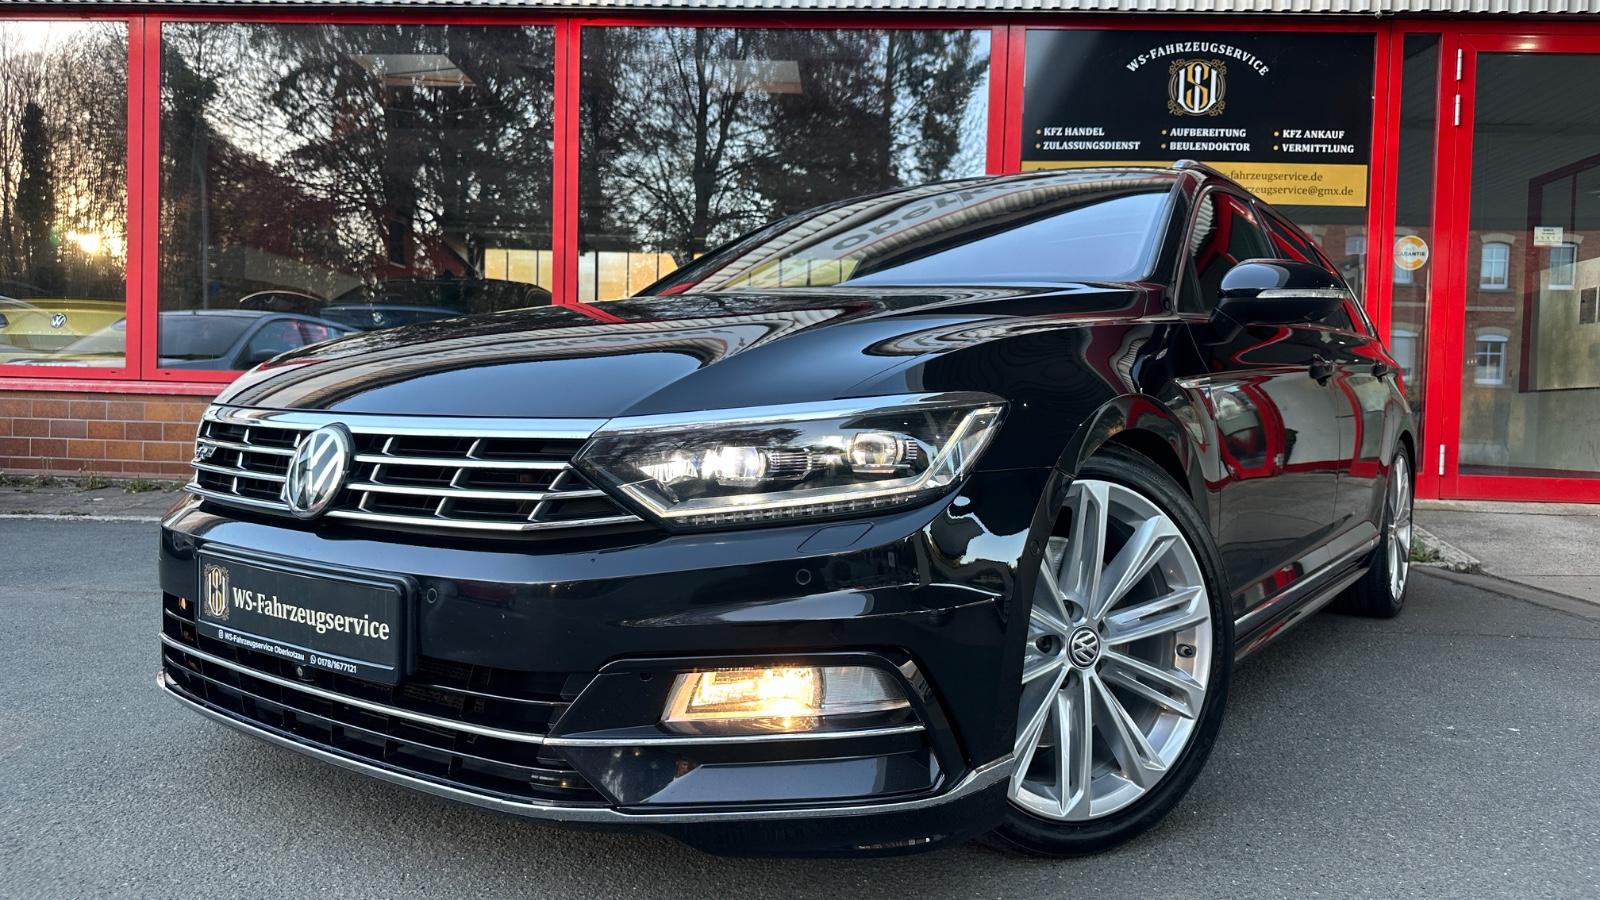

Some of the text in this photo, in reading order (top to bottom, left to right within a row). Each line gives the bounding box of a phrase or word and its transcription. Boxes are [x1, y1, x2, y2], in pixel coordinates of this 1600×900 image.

[1126, 42, 1269, 76] WS-FAHRZEUGSERVICE
[1044, 127, 1105, 136] KFZ HANDEL
[1169, 128, 1247, 137] AUFBEREITUNG
[1282, 129, 1345, 139] KFZ ANKAUF
[1043, 141, 1141, 150] ZULASSUNGSDIENST
[1169, 142, 1250, 151] BEULENDOKTOR
[1282, 144, 1354, 153] VERMITTLUNG
[232, 586, 390, 641] WS-Fahrzeugservice
[224, 632, 274, 653] WS-Fahrzeugservice
